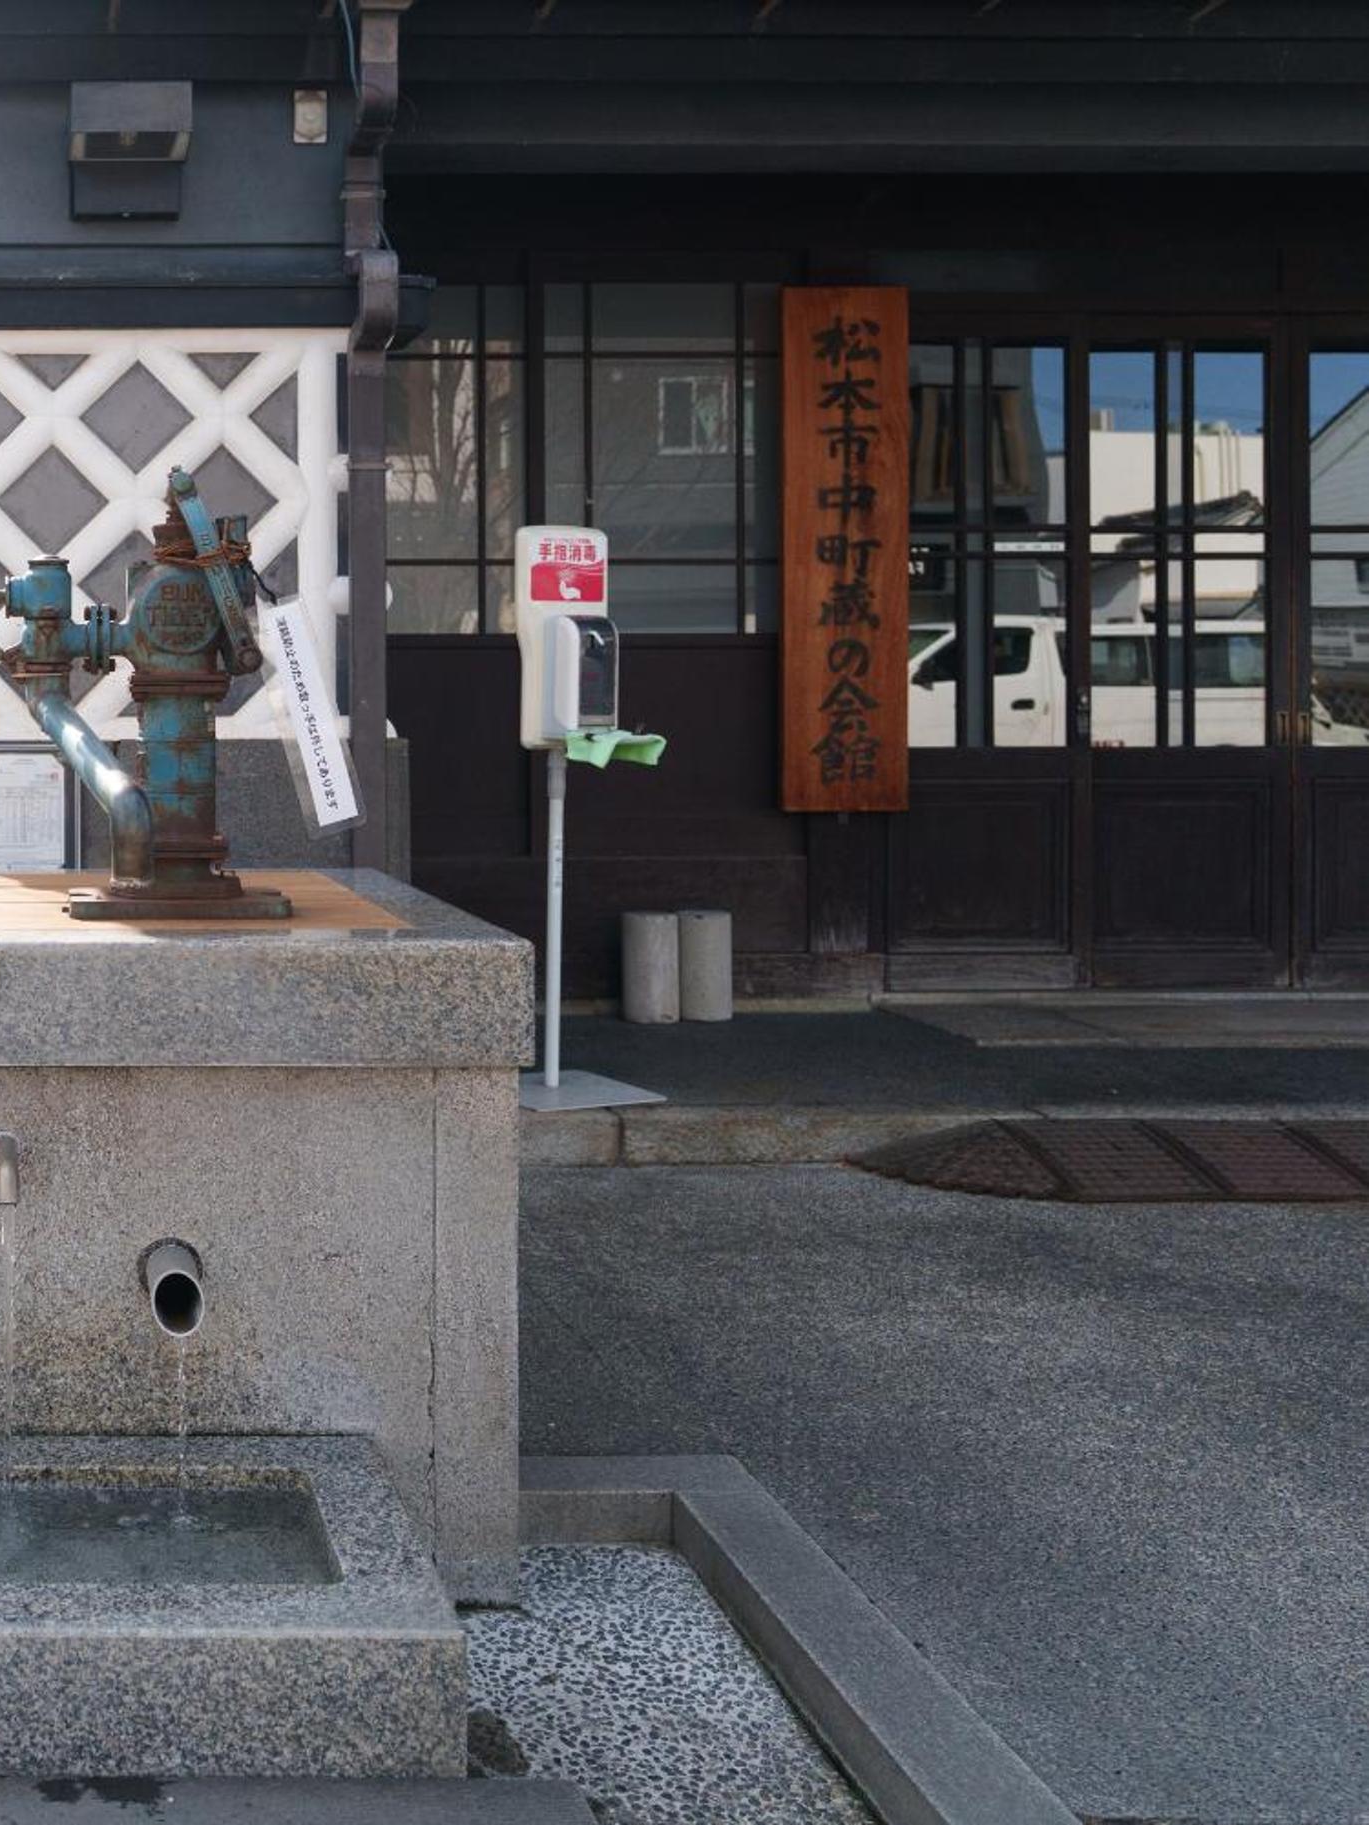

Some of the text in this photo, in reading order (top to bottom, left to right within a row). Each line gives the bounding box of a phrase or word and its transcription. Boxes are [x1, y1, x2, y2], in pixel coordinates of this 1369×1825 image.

[538, 543, 596, 562] 手指消毒
[811, 313, 883, 784] 松本市中町蔵の会館
